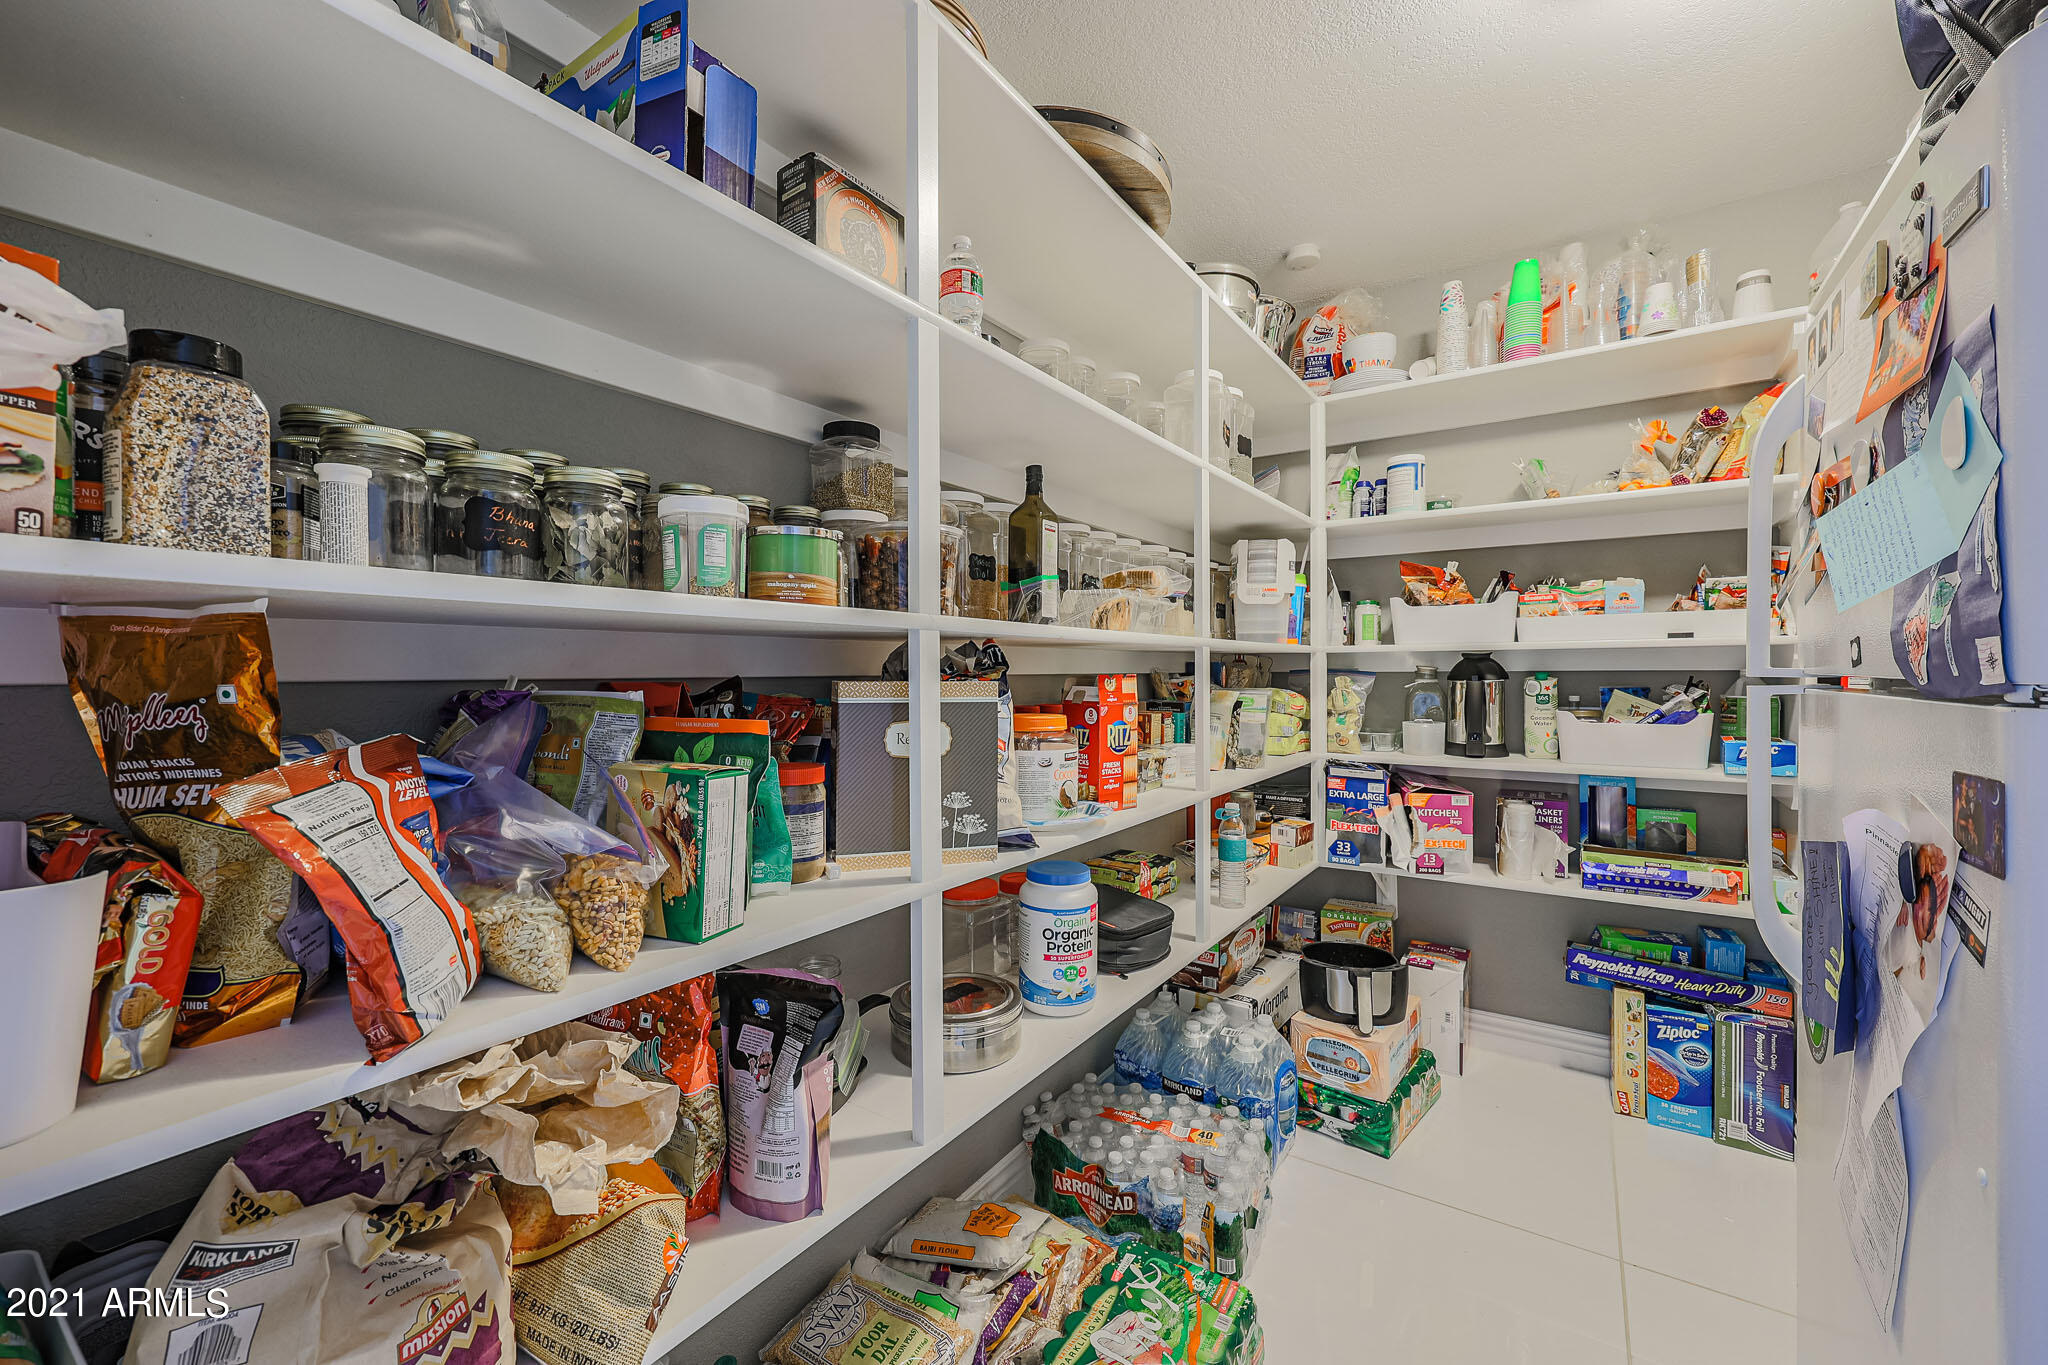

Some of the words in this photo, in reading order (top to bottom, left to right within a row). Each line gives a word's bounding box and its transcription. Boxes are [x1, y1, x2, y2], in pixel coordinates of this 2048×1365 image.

[584, 48, 620, 80] Walgreens
[548, 71, 565, 88] PACK
[851, 197, 870, 211] WHOLE
[18, 511, 41, 528] 50
[767, 581, 799, 589] mahogany
[1107, 725, 1131, 748] RITZ
[150, 757, 195, 768] SNACKS
[737, 758, 751, 766] KETO
[164, 768, 223, 779] INDIENNES
[1101, 768, 1122, 776] STACKS
[172, 784, 220, 806] SEV
[399, 789, 429, 802] LEVEL
[1329, 790, 1355, 799] EXTRA
[1357, 791, 1384, 802] LARGE
[308, 812, 349, 832] Nutrition
[350, 804, 370, 813] Facts
[1536, 808, 1563, 816] ASKET
[1331, 820, 1380, 834] FLEX-TECH
[1535, 816, 1563, 824] LINERS
[330, 837, 356, 851] Calories
[1336, 841, 1351, 851] 33
[1340, 857, 1356, 865] BAGS
[1424, 855, 1436, 863] 13
[1607, 863, 1646, 875] Reynolds
[1646, 867, 1671, 877] Wrap
[1327, 912, 1368, 923] ORGANIC
[1964, 895, 1987, 929] NIGHT
[1054, 917, 1087, 930] Orgain
[1330, 922, 1344, 931] TASTY
[1042, 926, 1094, 943] Organic
[1806, 919, 1814, 947] are
[135, 911, 175, 974] GOLD
[1047, 939, 1092, 953] Protein
[1057, 953, 1089, 961] SUPERFOODS
[1572, 952, 1636, 975] Reynolds
[1636, 965, 1674, 985] Wrap
[1674, 979, 1715, 996] Heavy
[1715, 982, 1747, 998] Duty
[1618, 972, 1646, 982] ALUMINUM
[1806, 956, 1820, 1000] you
[1767, 994, 1789, 1006] 150
[1656, 1025, 1700, 1041] Ziploc
[1755, 1031, 1766, 1063] Reynolds
[1164, 1079, 1202, 1097] KIRKLAND
[1756, 1071, 1765, 1116] Foodservice
[1618, 1092, 1630, 1114] GLAD
[1671, 1105, 1698, 1114] FREEZER
[1114, 1110, 1151, 1124] ARROWHEAD
[1756, 1117, 1765, 1133] Foil
[1197, 1131, 1214, 1140] 40
[1054, 1175, 1133, 1211] ARROWHEAD
[189, 1244, 288, 1267] KIRKLAND
[938, 1246, 959, 1255] FLOUR
[382, 1271, 397, 1283] No
[385, 1277, 421, 1297] Gluten
[423, 1266, 442, 1279] Free
[1093, 1294, 1116, 1324] WATER
[804, 1285, 859, 1350] SWAD
[529, 1301, 551, 1318] 9.07
[550, 1310, 568, 1328] KG
[571, 1319, 587, 1338] (20
[590, 1330, 620, 1351] LBS)
[837, 1331, 846, 1339] IN
[852, 1321, 890, 1359] TOOR
[905, 1328, 919, 1348] PEAS)
[526, 1326, 556, 1351] MADE
[558, 1343, 569, 1361] IN
[871, 1336, 900, 1364] DAL
[1058, 1330, 1083, 1360] NATURALLY
